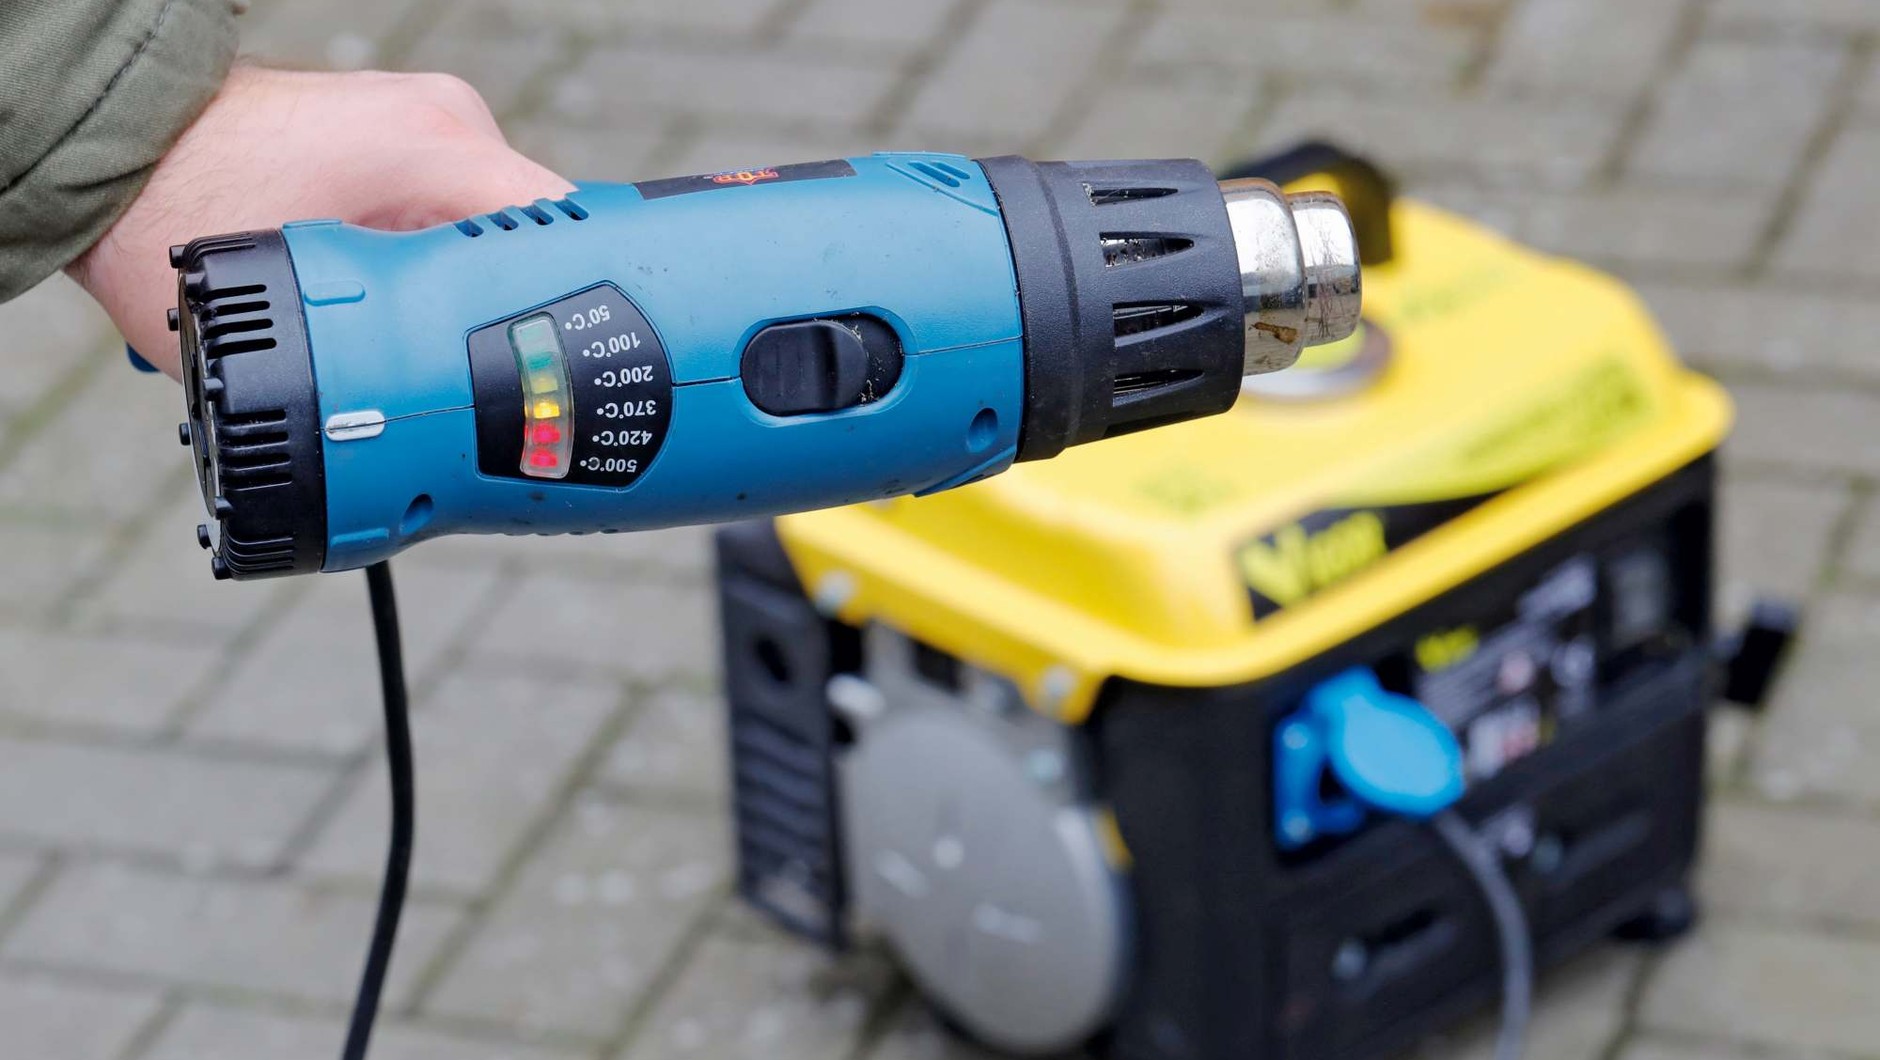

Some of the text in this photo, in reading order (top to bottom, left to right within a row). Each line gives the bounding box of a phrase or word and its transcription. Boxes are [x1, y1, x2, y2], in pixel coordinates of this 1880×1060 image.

[602, 365, 654, 387] 200°C
[605, 400, 657, 419] 370°C
[600, 430, 653, 447] 420°C
